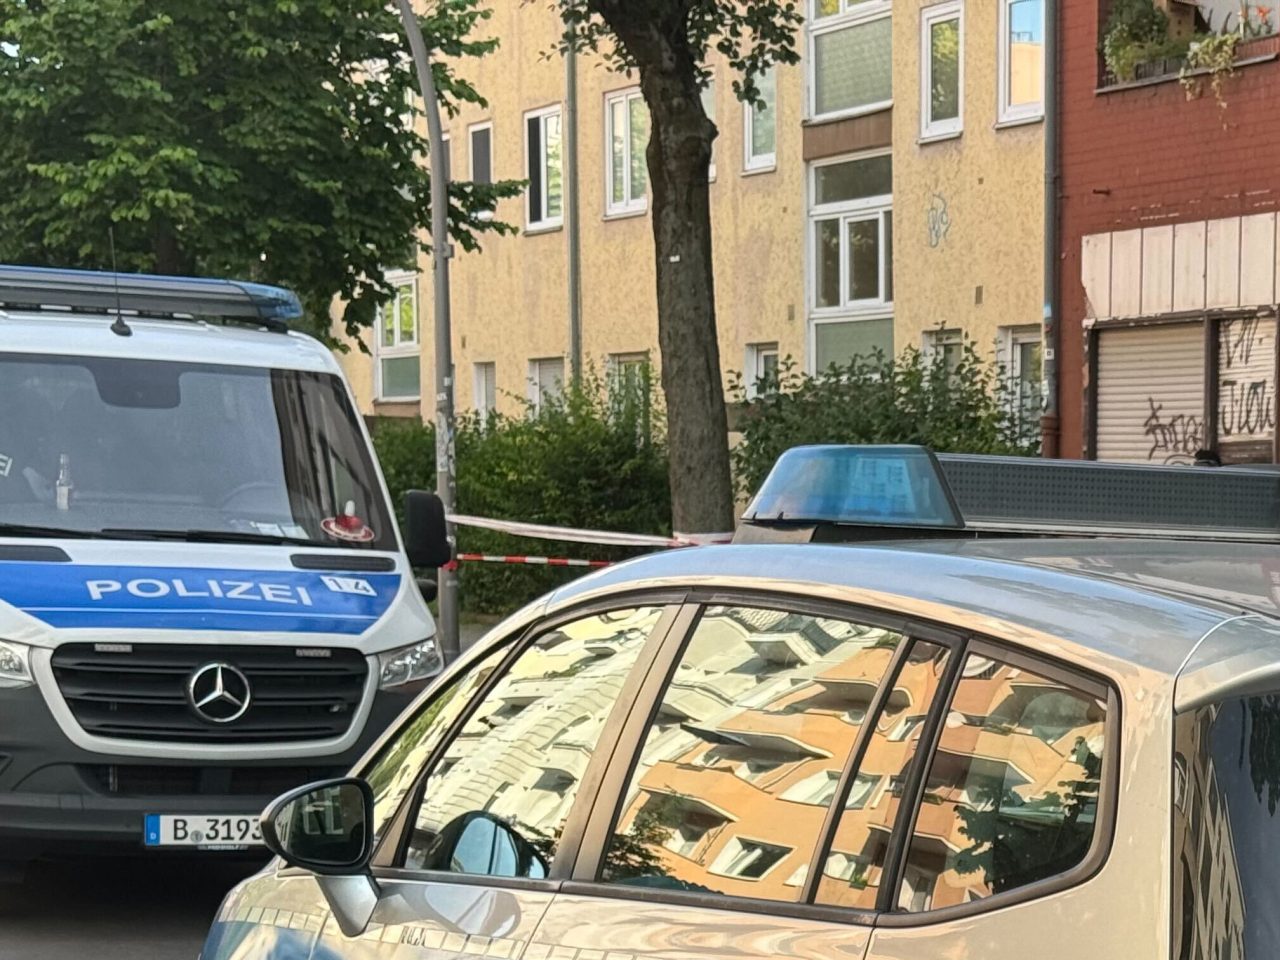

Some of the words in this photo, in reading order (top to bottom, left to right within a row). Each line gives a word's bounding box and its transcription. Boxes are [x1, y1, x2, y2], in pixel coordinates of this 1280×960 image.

[86, 578, 312, 607] POLIZEI
[173, 819, 188, 840] B
[205, 818, 262, 841] 3193
